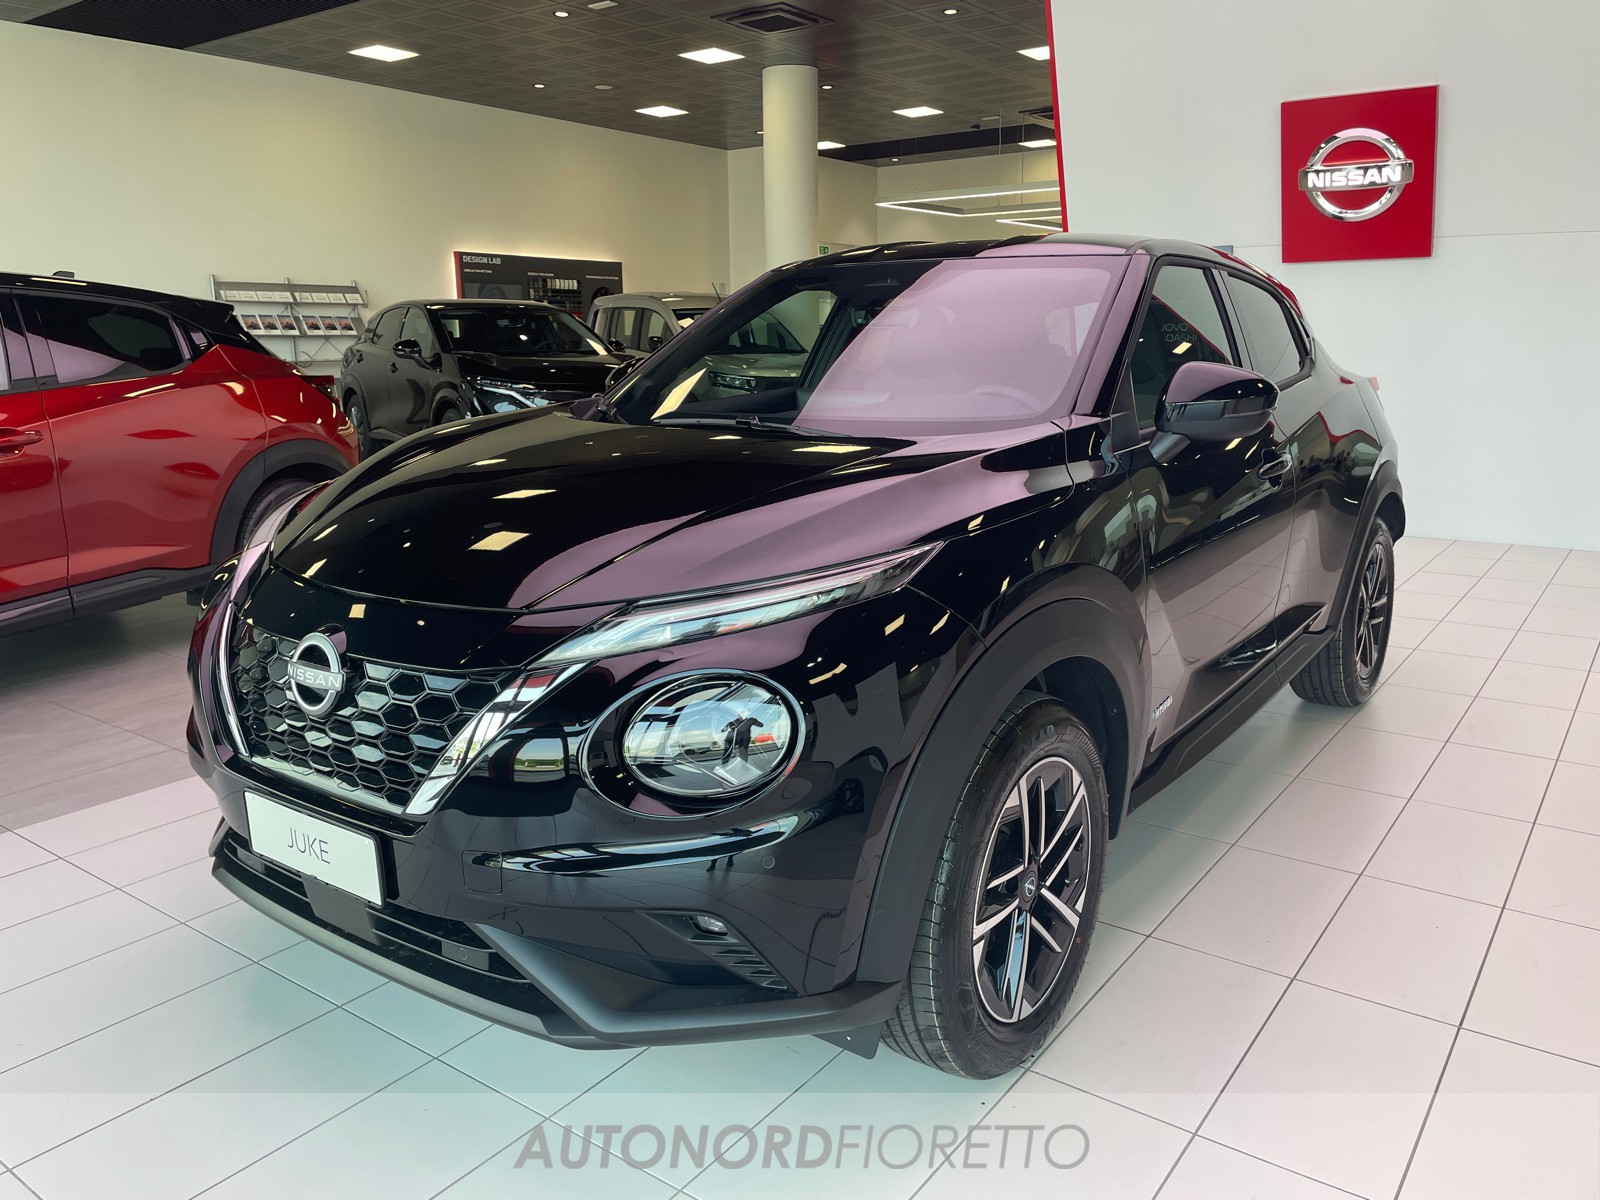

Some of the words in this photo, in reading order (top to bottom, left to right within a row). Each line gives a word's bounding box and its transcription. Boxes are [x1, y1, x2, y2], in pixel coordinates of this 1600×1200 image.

[1307, 165, 1402, 188] NISSAN
[462, 255, 488, 264] DESIGN
[488, 257, 502, 265] LAB
[287, 663, 340, 688] NISSAN
[287, 827, 331, 864] JUKE
